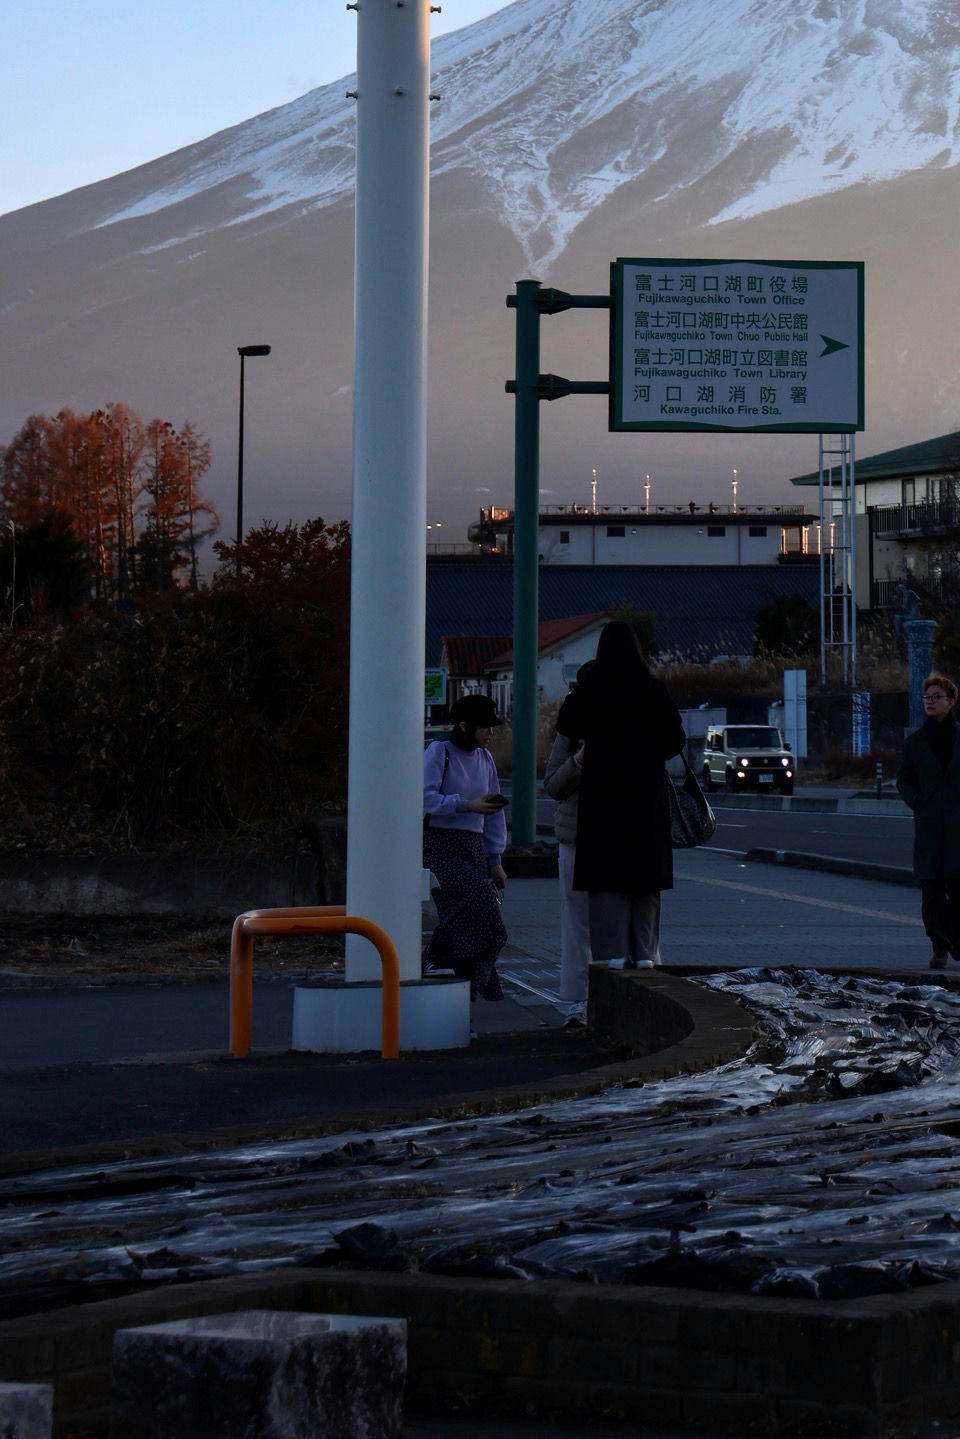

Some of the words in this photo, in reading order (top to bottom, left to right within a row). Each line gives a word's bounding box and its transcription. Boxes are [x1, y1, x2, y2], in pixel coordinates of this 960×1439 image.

[635, 274, 809, 293] 富士河口湖町役場
[638, 293, 731, 305] Fujikawaguchiko
[737, 294, 767, 305] Town
[773, 295, 805, 305] Office
[634, 311, 809, 330] 富士河口湖町中央公民館
[634, 331, 705, 342] Fujikawaguchiko
[710, 332, 733, 341] Town
[737, 332, 760, 341] Chuo
[764, 332, 790, 342] Public
[792, 333, 808, 342] Hall
[634, 348, 808, 367] 富士河口湖町立図書館
[634, 368, 727, 379] Fujikawaguchiko
[733, 369, 763, 378] Town
[769, 369, 807, 380] Library
[633, 385, 808, 404] 河口湖消防署
[660, 405, 734, 416] Kawaguchiko
[737, 405, 758, 415] Fire
[761, 405, 782, 415] Sta.
